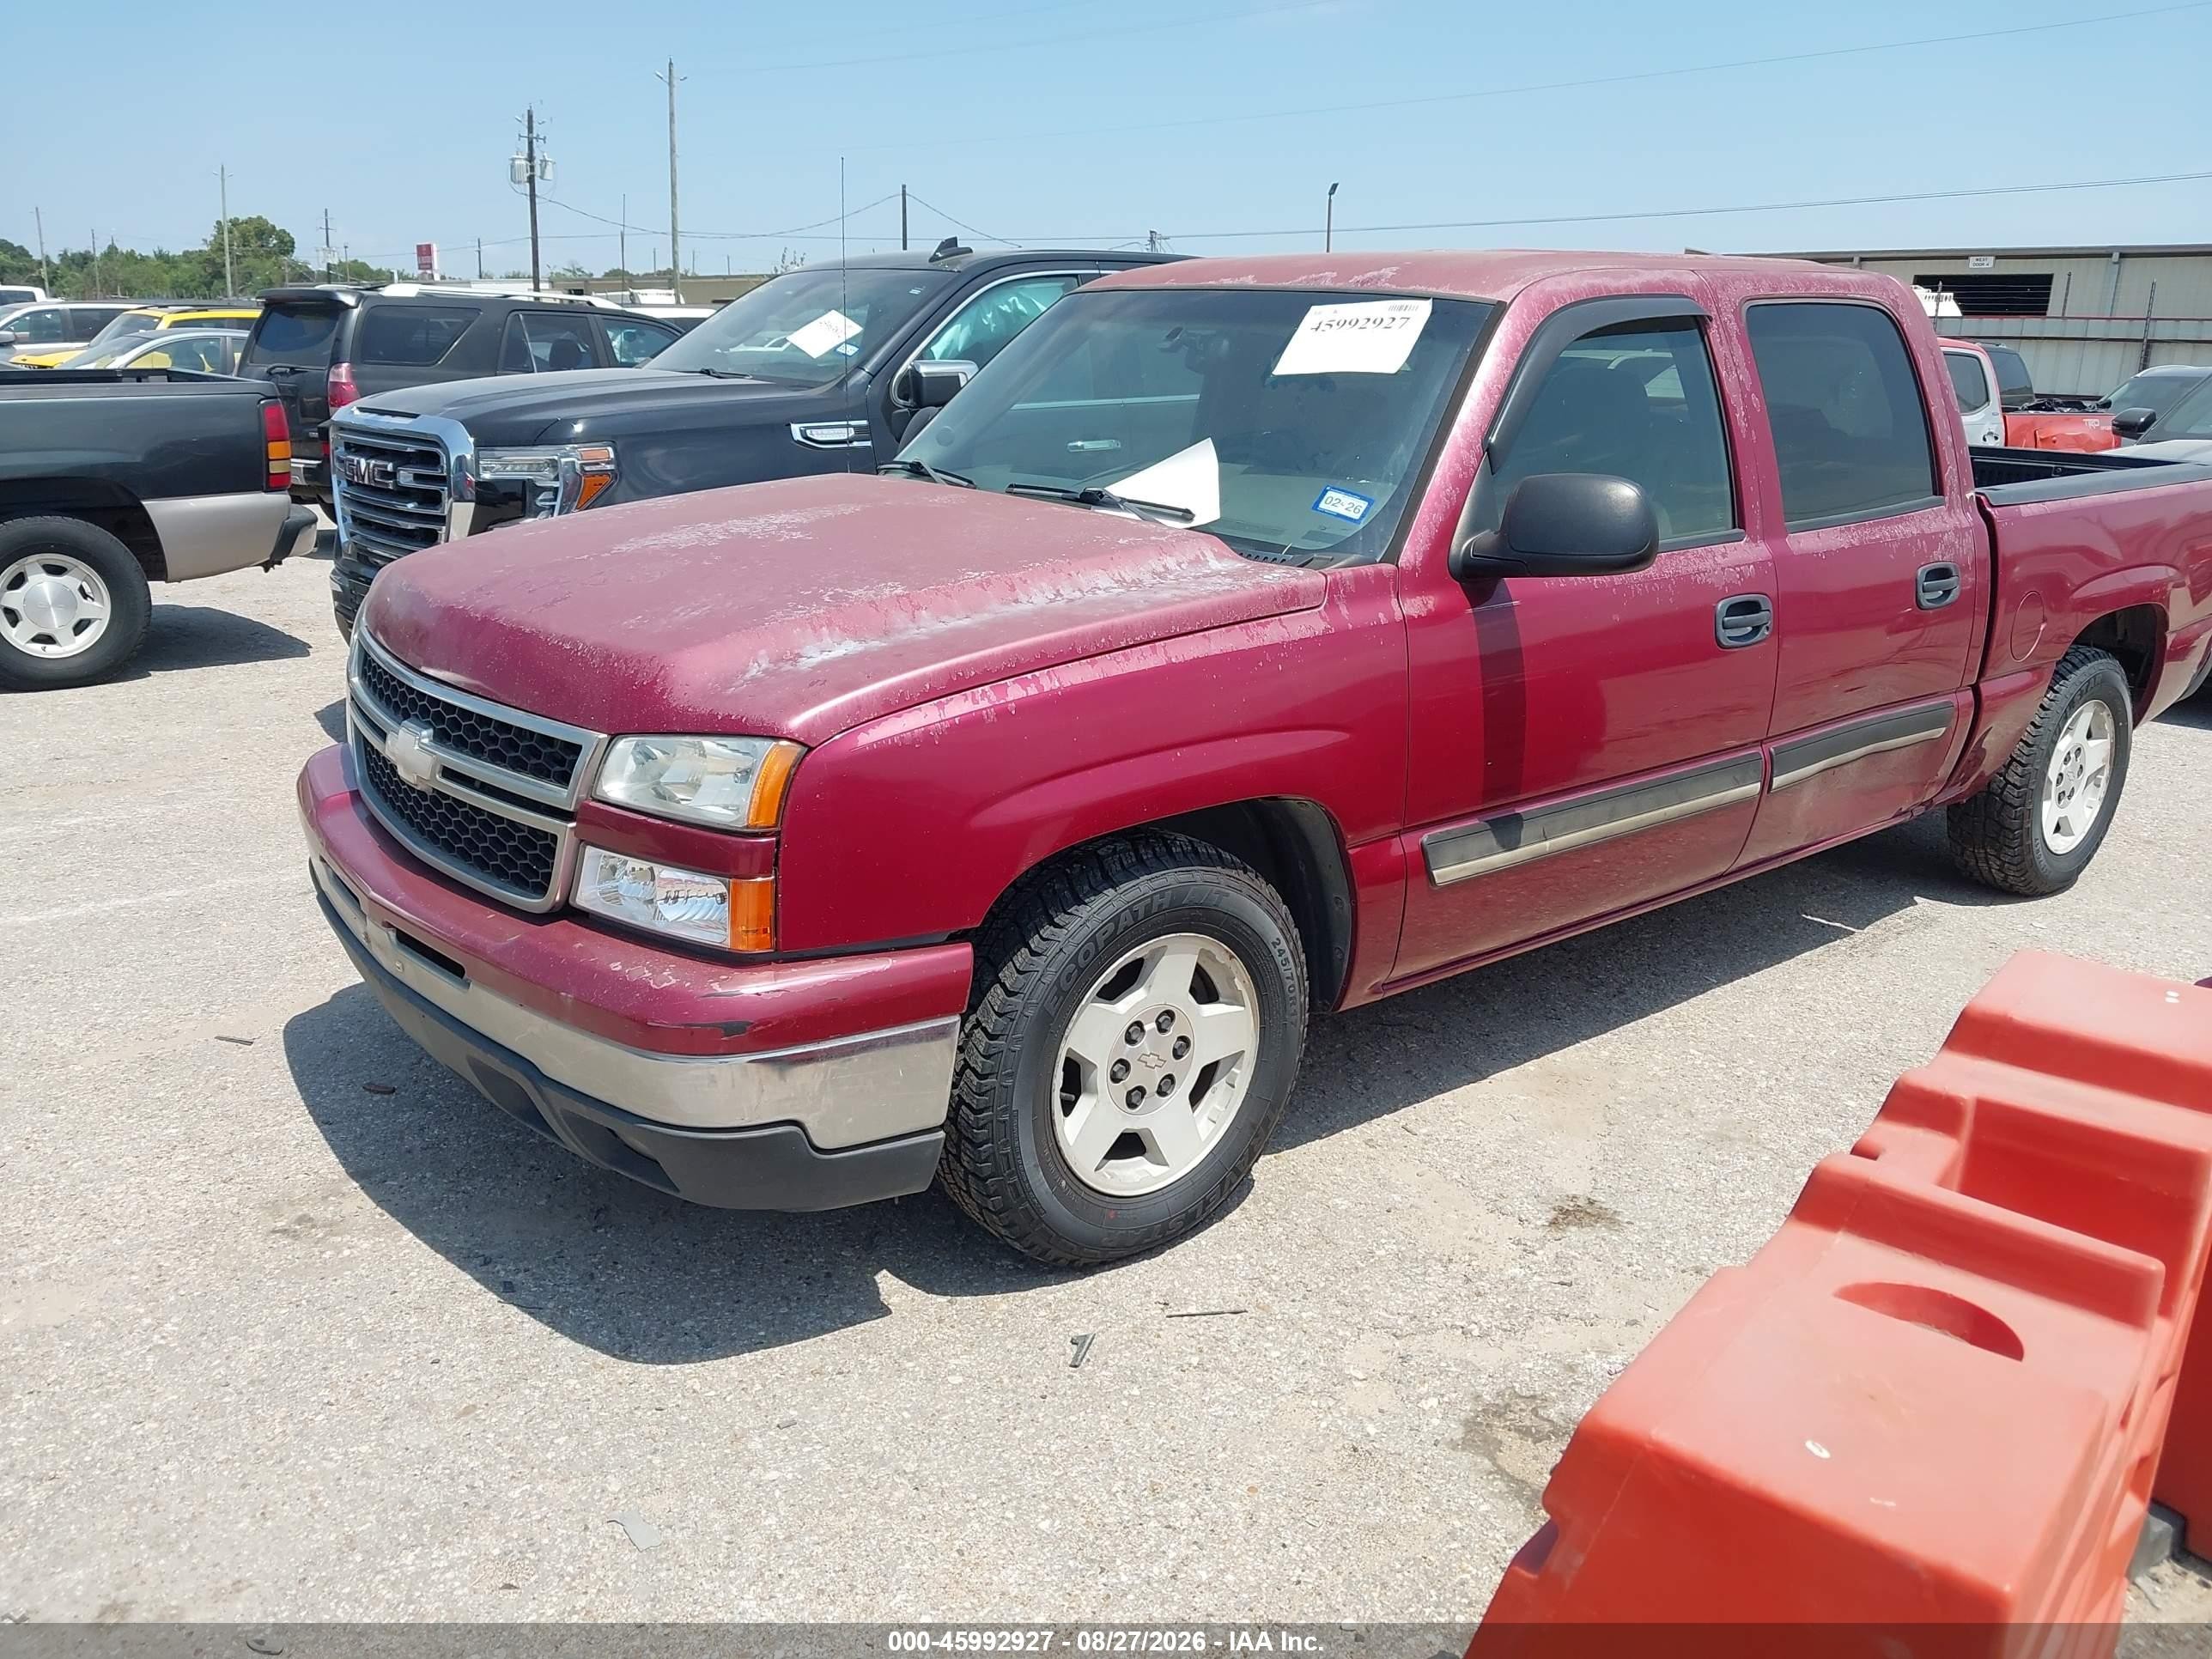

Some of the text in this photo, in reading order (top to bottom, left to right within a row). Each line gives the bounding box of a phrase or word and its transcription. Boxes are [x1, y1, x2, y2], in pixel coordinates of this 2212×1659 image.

[1310, 317, 1411, 332] 45992927
[2082, 418, 2100, 429] TRD
[343, 455, 394, 490] GMC
[1043, 886, 1231, 1017] ECOPATH A/T
[1271, 937, 1299, 1030] 245/70R17
